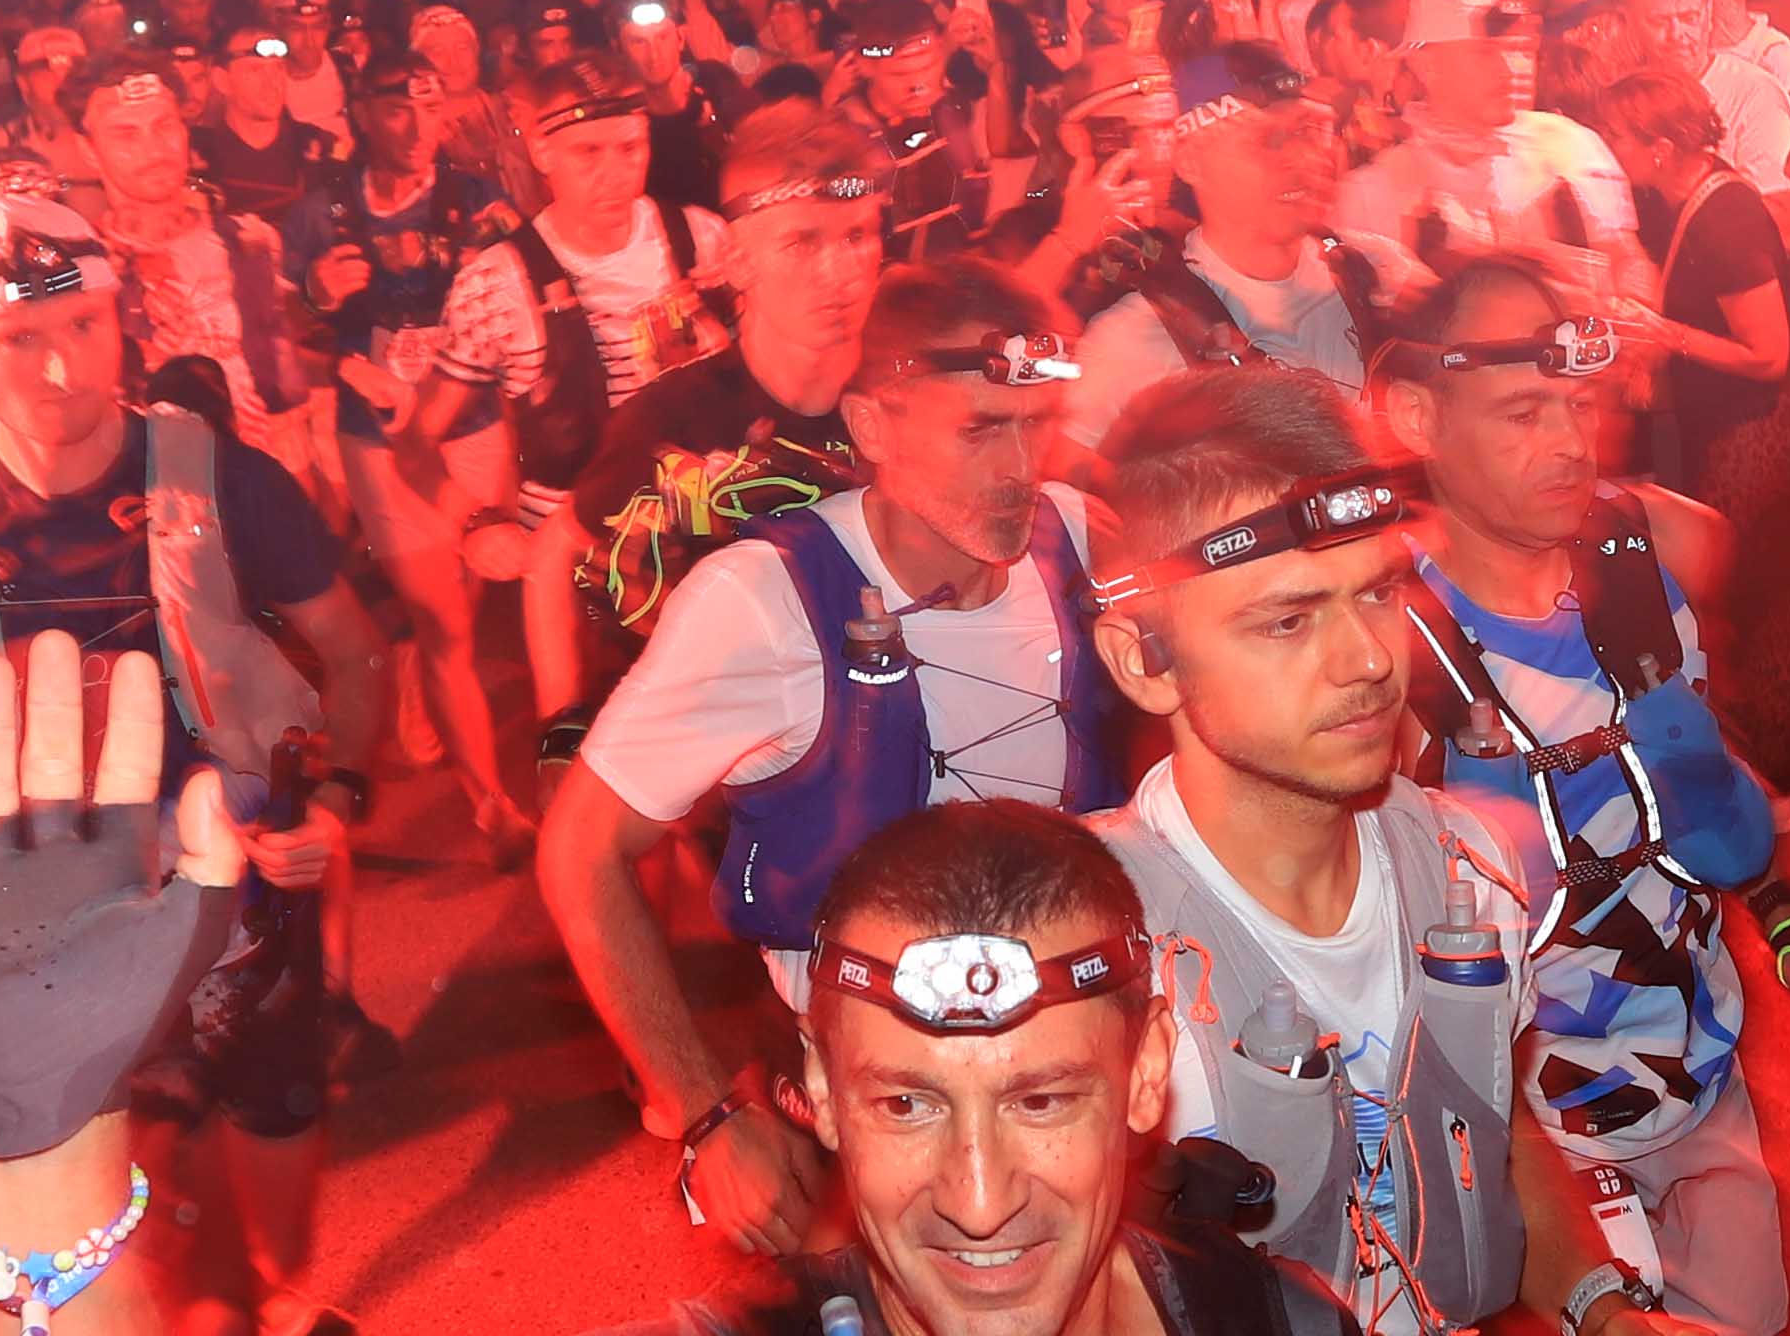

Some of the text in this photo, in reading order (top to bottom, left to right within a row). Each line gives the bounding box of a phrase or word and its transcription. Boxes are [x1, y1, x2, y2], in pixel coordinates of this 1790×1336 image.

[1174, 94, 1244, 137] SILVA
[1443, 353, 1467, 368] PETZL
[1207, 531, 1257, 565] PETZL
[838, 956, 1109, 989] PETZL PETZL
